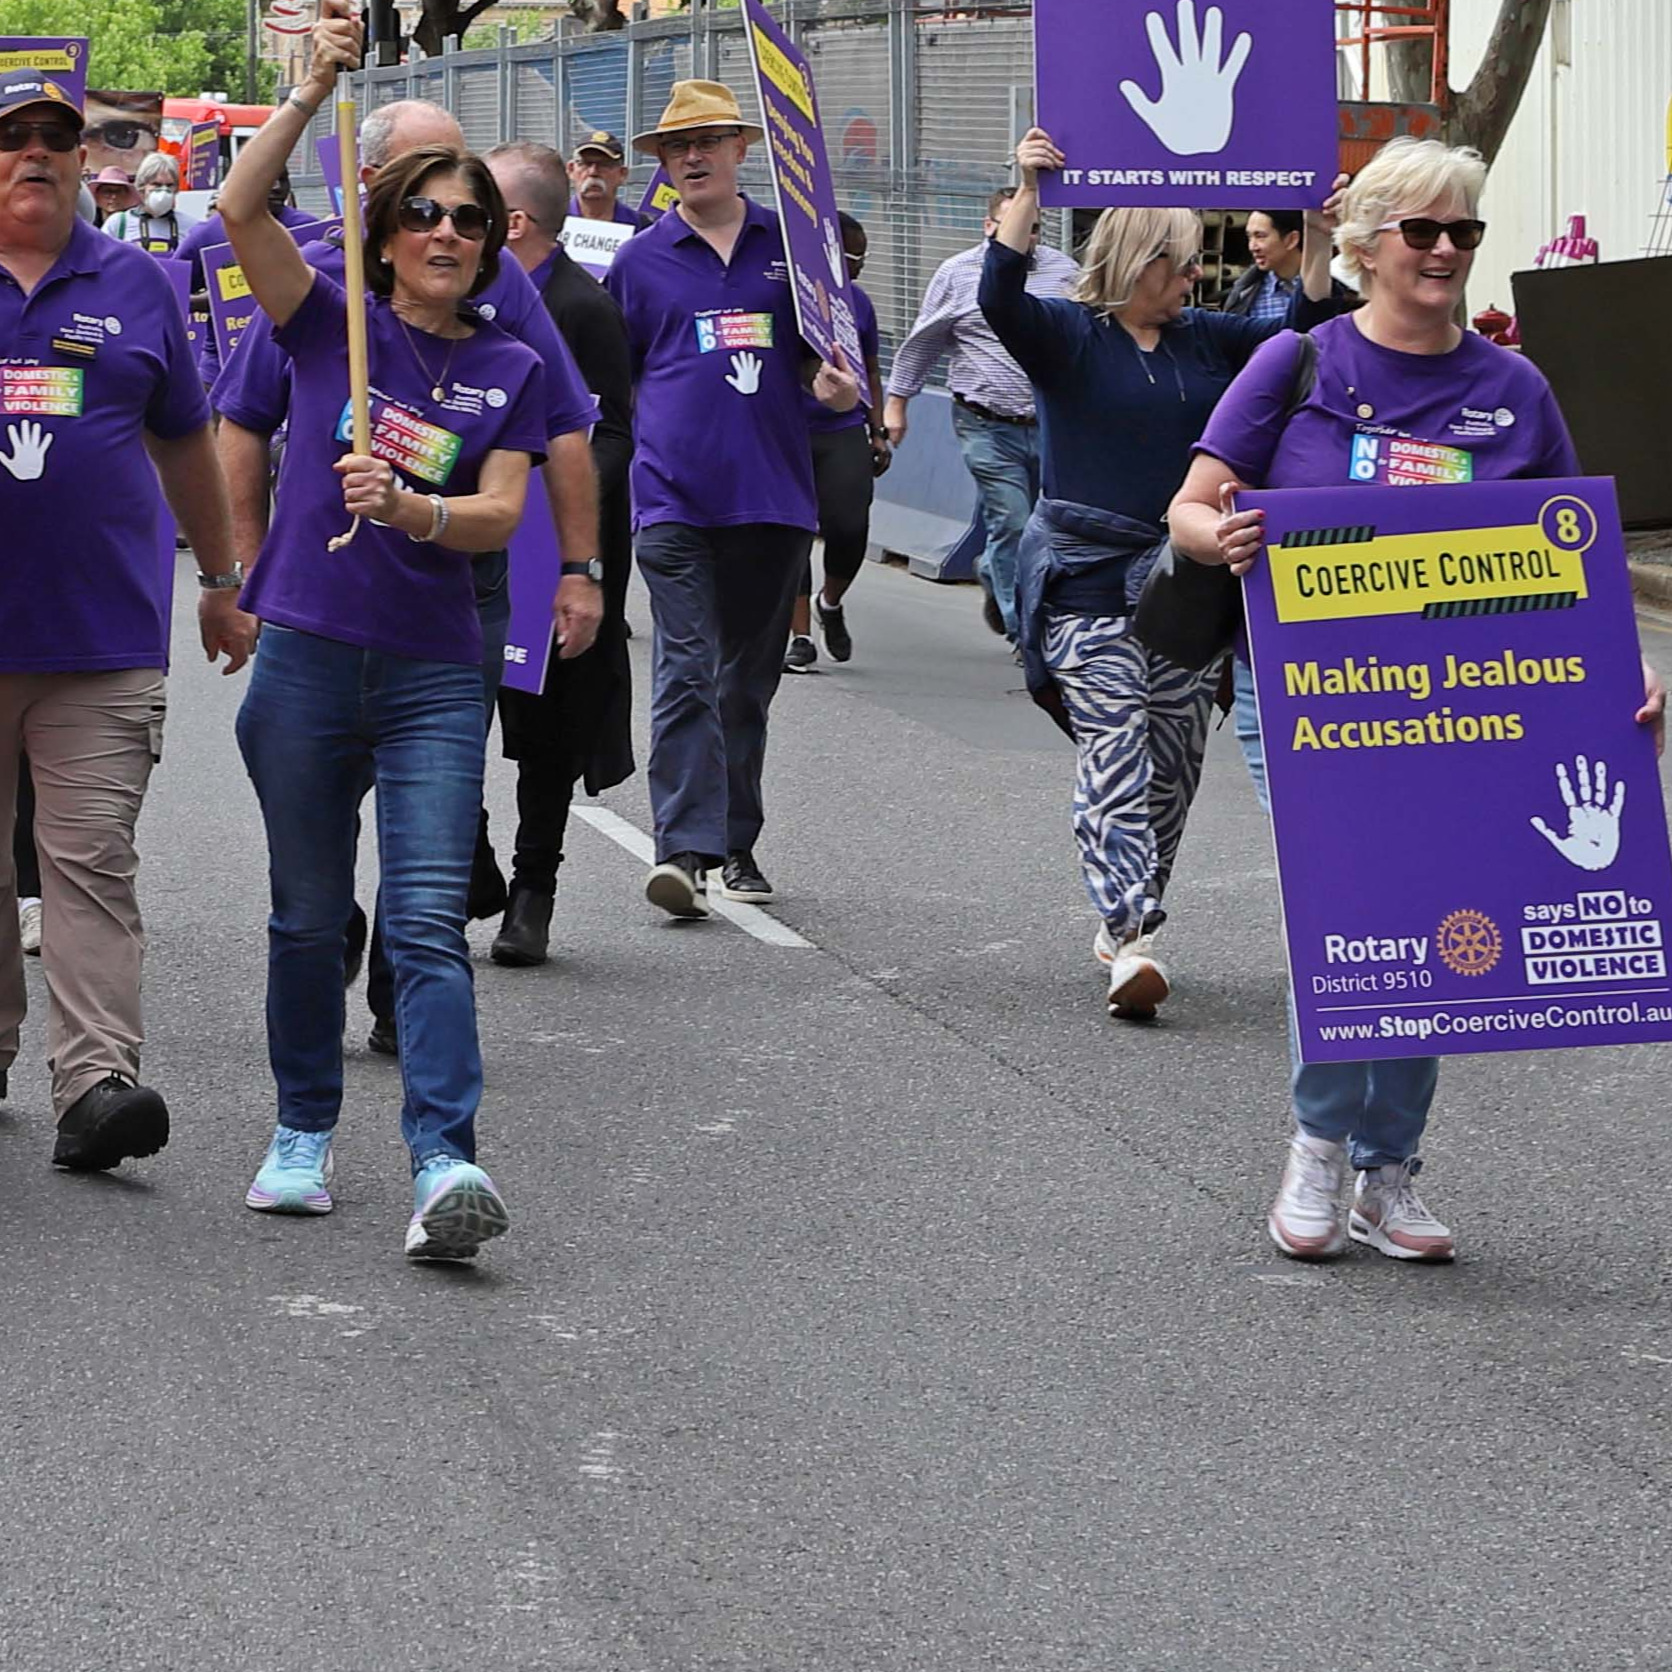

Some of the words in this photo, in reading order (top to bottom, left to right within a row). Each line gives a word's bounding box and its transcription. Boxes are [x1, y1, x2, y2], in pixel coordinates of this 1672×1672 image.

[69, 46, 77, 56] 9
[1063, 170, 1083, 187] IT
[1087, 170, 1164, 187] STARTS
[1167, 170, 1222, 187] WITH
[1225, 170, 1316, 187] RESPECT
[3, 369, 71, 381] DOMESTIC
[3, 385, 79, 397] FAMILY
[3, 401, 79, 413] VIOLENCE
[381, 407, 450, 446] DOMESTIC
[374, 423, 452, 465] FAMILY
[1355, 437, 1379, 479] NO
[1389, 441, 1460, 462] DOMESTIC
[370, 439, 446, 483] VIOLENCE
[1388, 458, 1468, 481] FAMILY
[1555, 507, 1581, 544] 8
[1296, 556, 1429, 598] COERCIVE
[1439, 548, 1561, 586] CONTROL
[1284, 657, 1431, 700] Making
[1443, 650, 1587, 689] Jealous
[1292, 708, 1525, 752] Accusations
[1523, 900, 1576, 924] says
[1583, 894, 1621, 918] NO
[1628, 893, 1652, 916] to
[1324, 931, 1429, 968] Rotary
[1530, 925, 1656, 952] DOMESTIC
[1312, 973, 1377, 997] District
[1383, 969, 1433, 992] 9510
[1532, 953, 1660, 982] VIOLENCE
[1319, 1001, 1672, 1042] www.StopCoerciveControl.au
